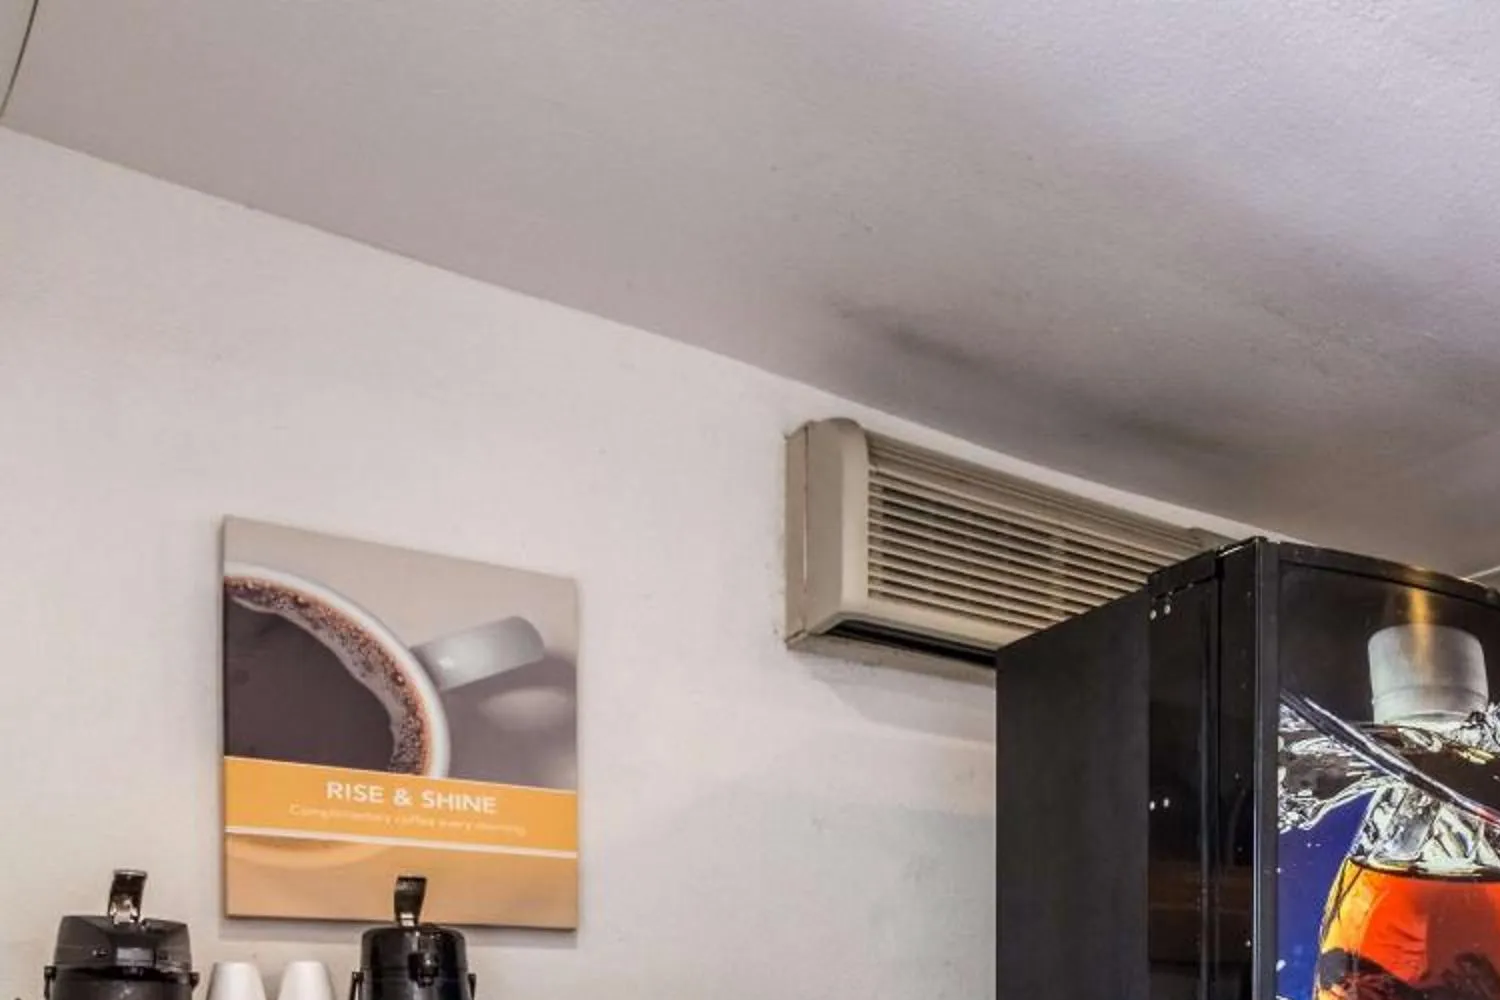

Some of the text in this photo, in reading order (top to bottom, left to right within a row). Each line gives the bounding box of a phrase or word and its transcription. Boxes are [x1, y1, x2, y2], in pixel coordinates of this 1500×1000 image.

[326, 781, 498, 815] RISE & SHINE
